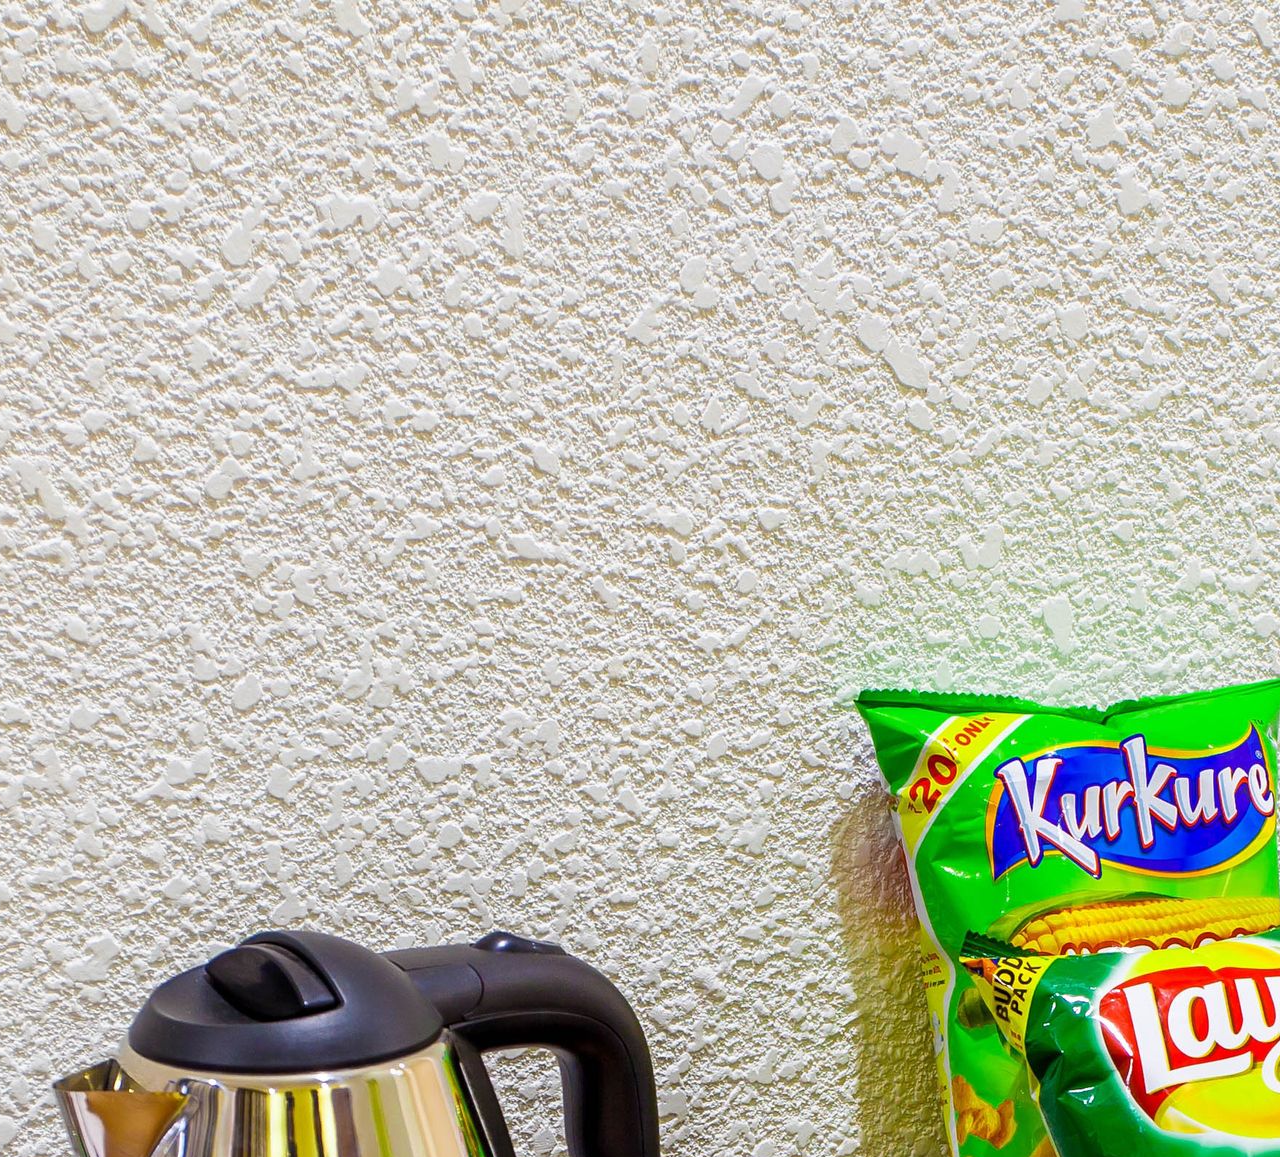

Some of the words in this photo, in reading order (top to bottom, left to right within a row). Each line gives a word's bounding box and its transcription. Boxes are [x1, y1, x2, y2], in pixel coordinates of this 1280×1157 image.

[995, 734, 1276, 879] Kurkure
[993, 957, 1024, 1023] BUDD
[1010, 962, 1042, 1016] PACK
